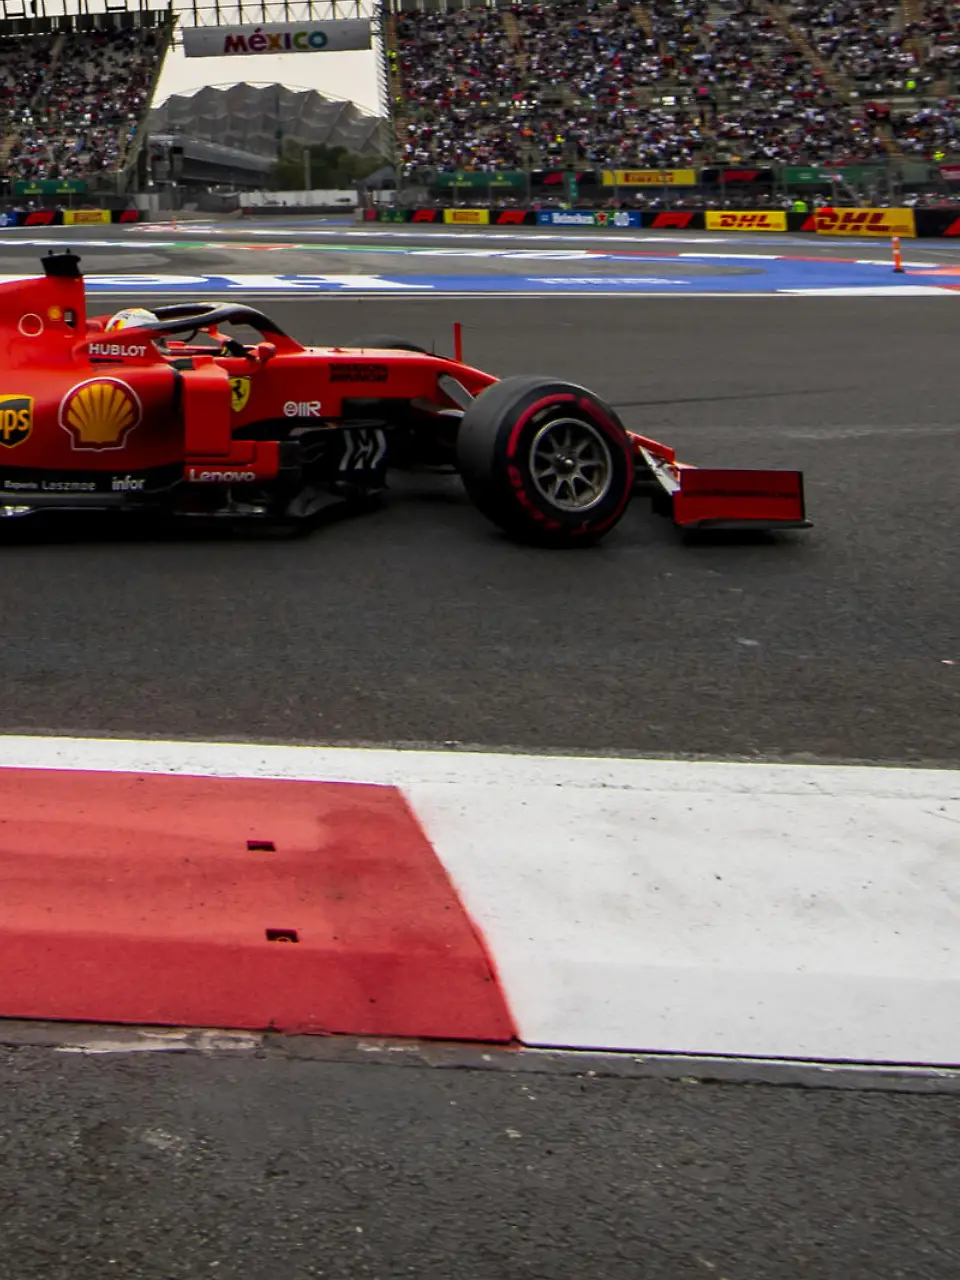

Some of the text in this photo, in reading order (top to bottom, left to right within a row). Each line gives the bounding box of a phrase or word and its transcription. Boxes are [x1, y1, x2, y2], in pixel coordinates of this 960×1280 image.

[719, 214, 772, 227] DHL
[815, 211, 891, 232] DHL
[88, 341, 148, 357] HUBLOT
[189, 468, 257, 483] Lenovo
[111, 476, 146, 491] infor
